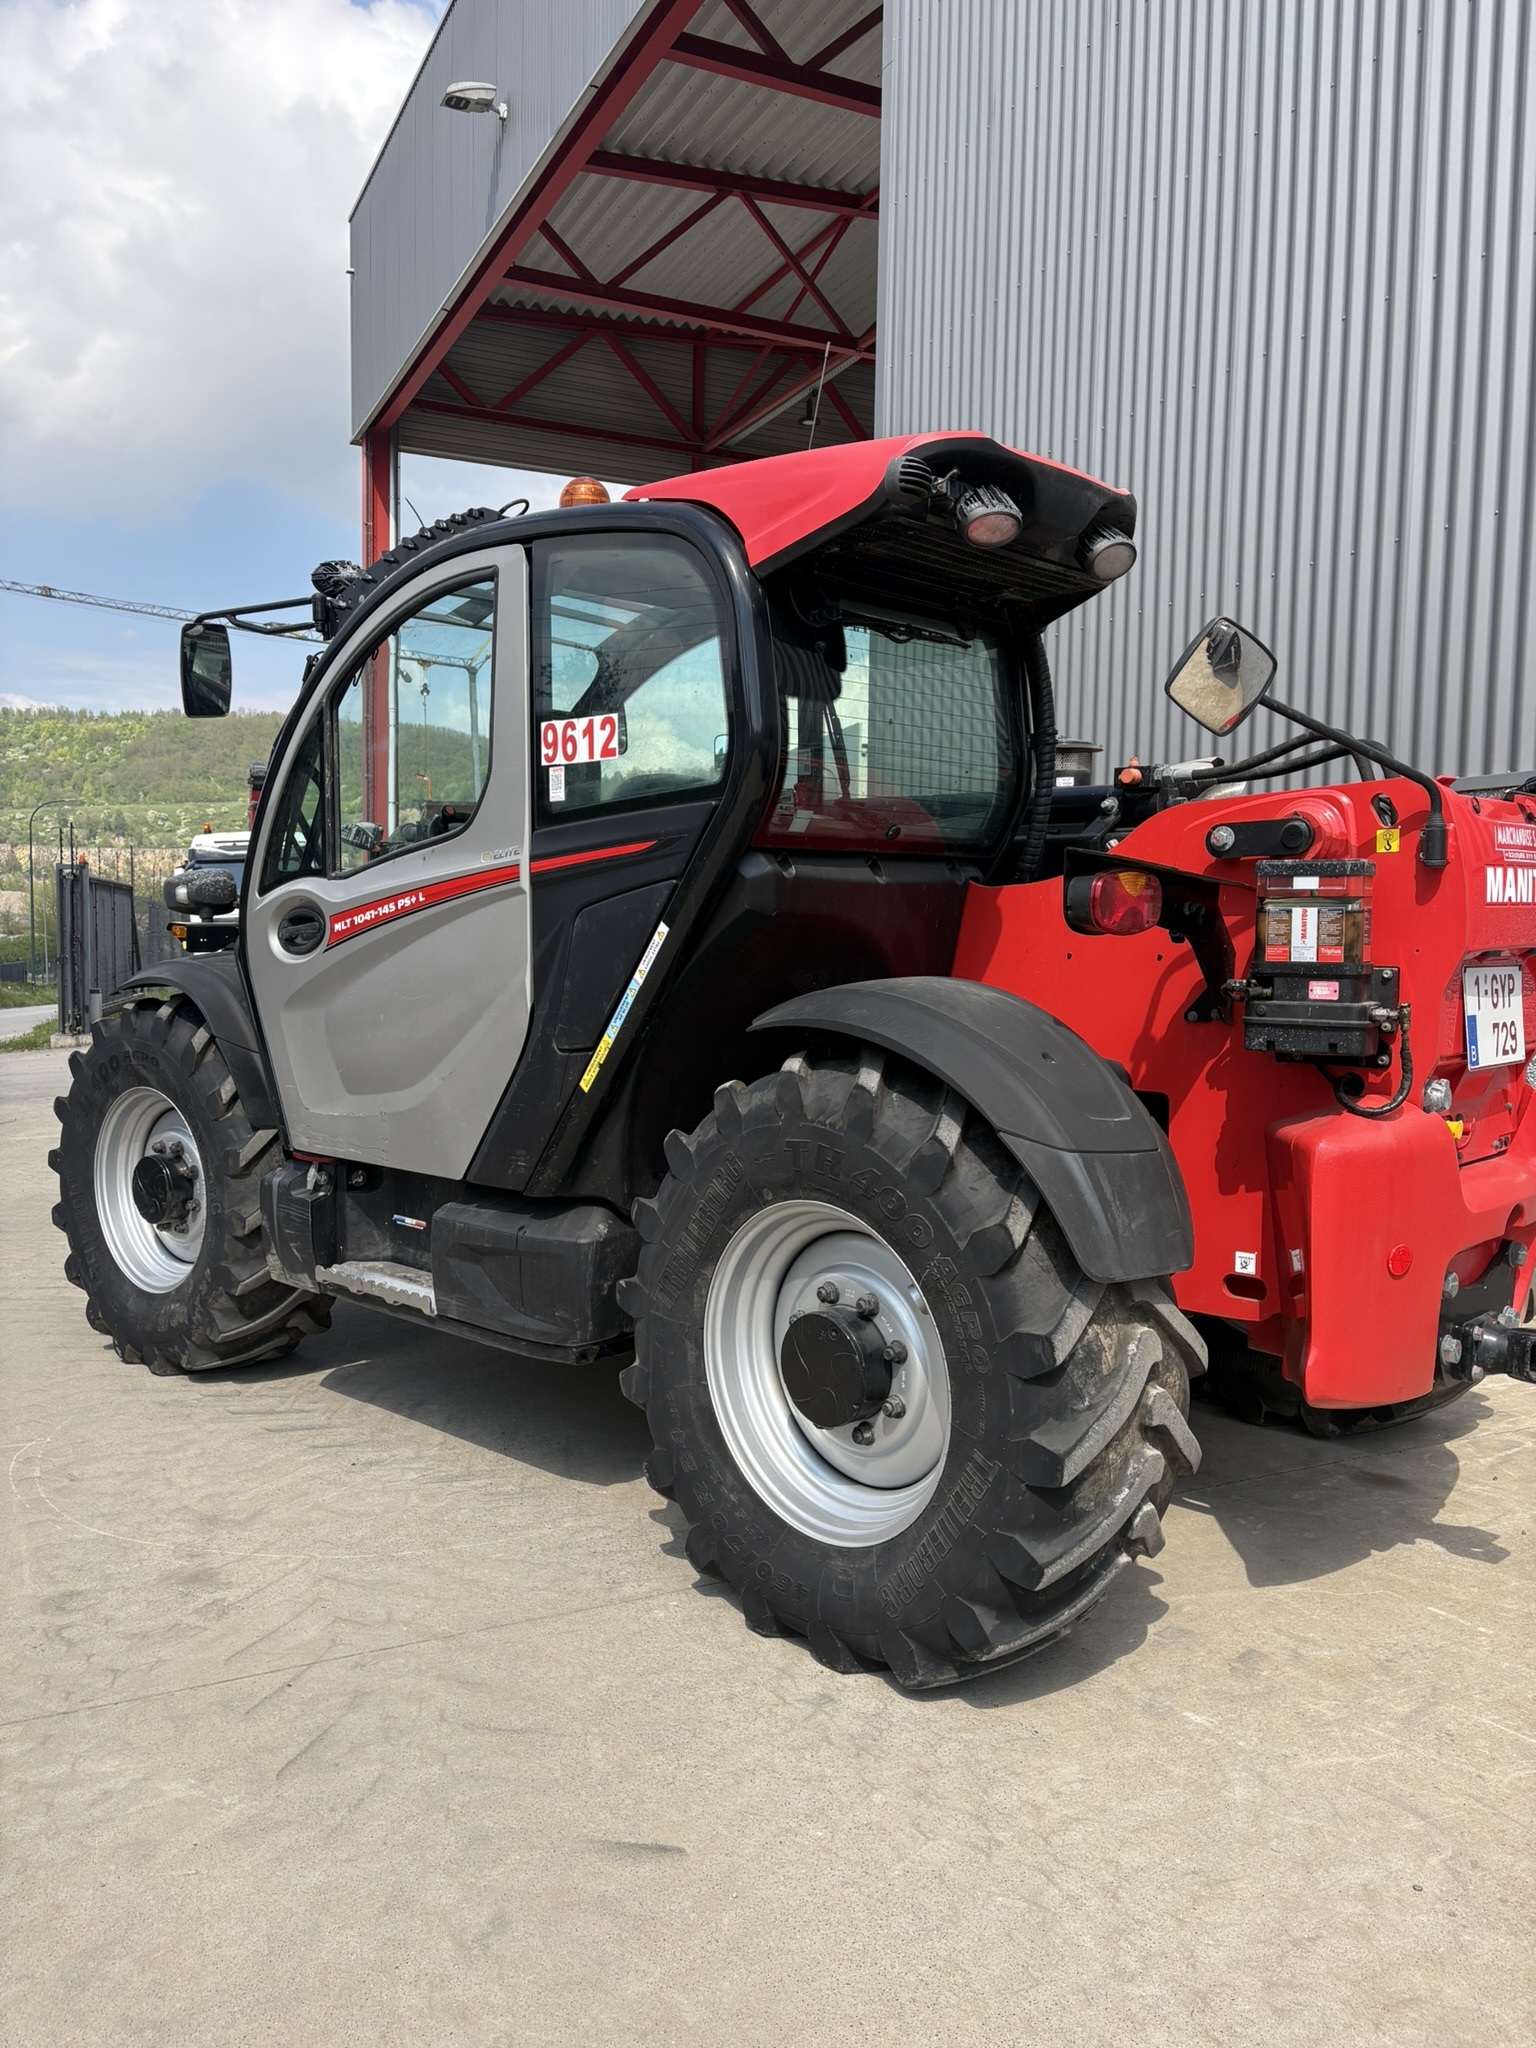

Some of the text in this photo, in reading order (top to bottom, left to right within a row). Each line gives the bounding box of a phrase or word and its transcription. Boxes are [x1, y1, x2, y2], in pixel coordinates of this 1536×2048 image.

[543, 715, 617, 764] 9612
[493, 845, 520, 860] ELITE
[334, 892, 425, 932] MLT 1041-145 PS+ L
[1300, 908, 1308, 940] MANITOU
[1321, 947, 1341, 956] Triplus
[1471, 1046, 1477, 1062] B
[1492, 1020, 1518, 1057] 729
[654, 1153, 743, 1310] TRELLEBORG
[784, 1139, 990, 1375] TH 400 AGRO
[880, 1449, 1001, 1619] TRELLEBORG
